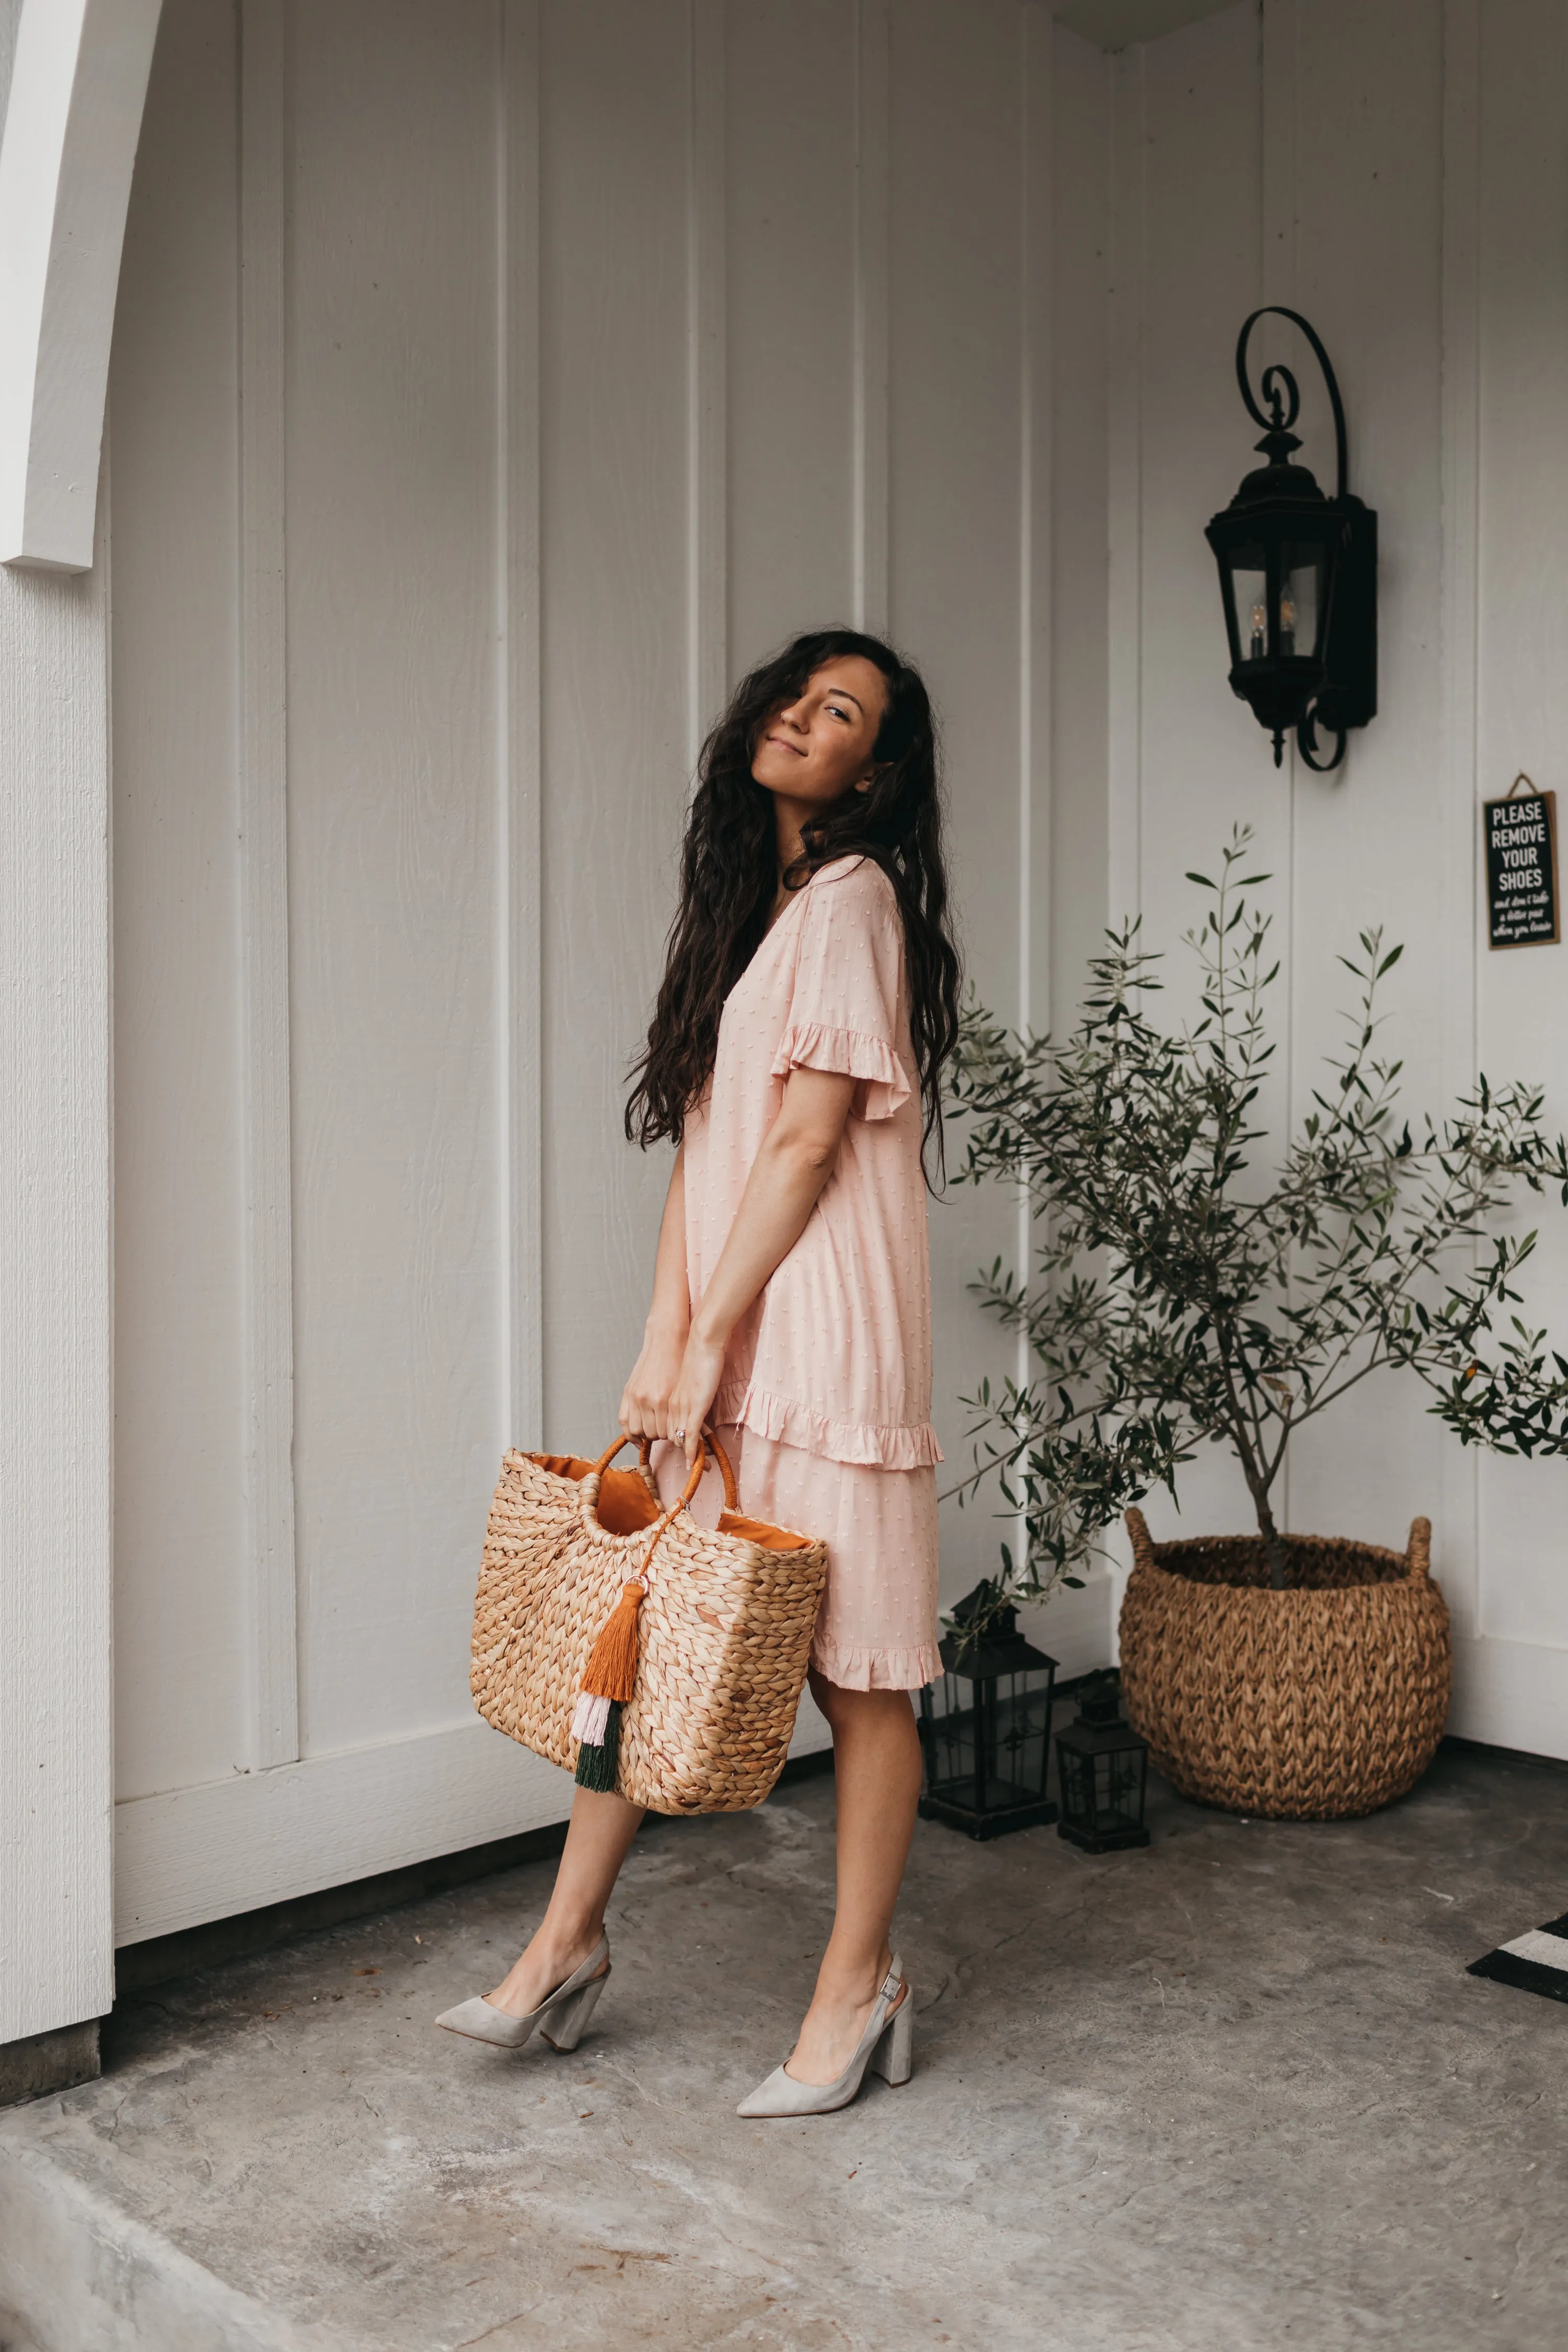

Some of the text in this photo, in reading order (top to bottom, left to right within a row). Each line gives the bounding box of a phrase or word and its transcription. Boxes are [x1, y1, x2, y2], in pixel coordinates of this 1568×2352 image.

[1493, 801, 1542, 827] PLEASE
[1492, 824, 1546, 849] REMOVE
[1502, 847, 1537, 869] YOUR
[1499, 869, 1542, 891] SHOES
[1494, 896, 1510, 909] and
[1512, 895, 1531, 907] don't
[1493, 920, 1552, 940] when you leave
